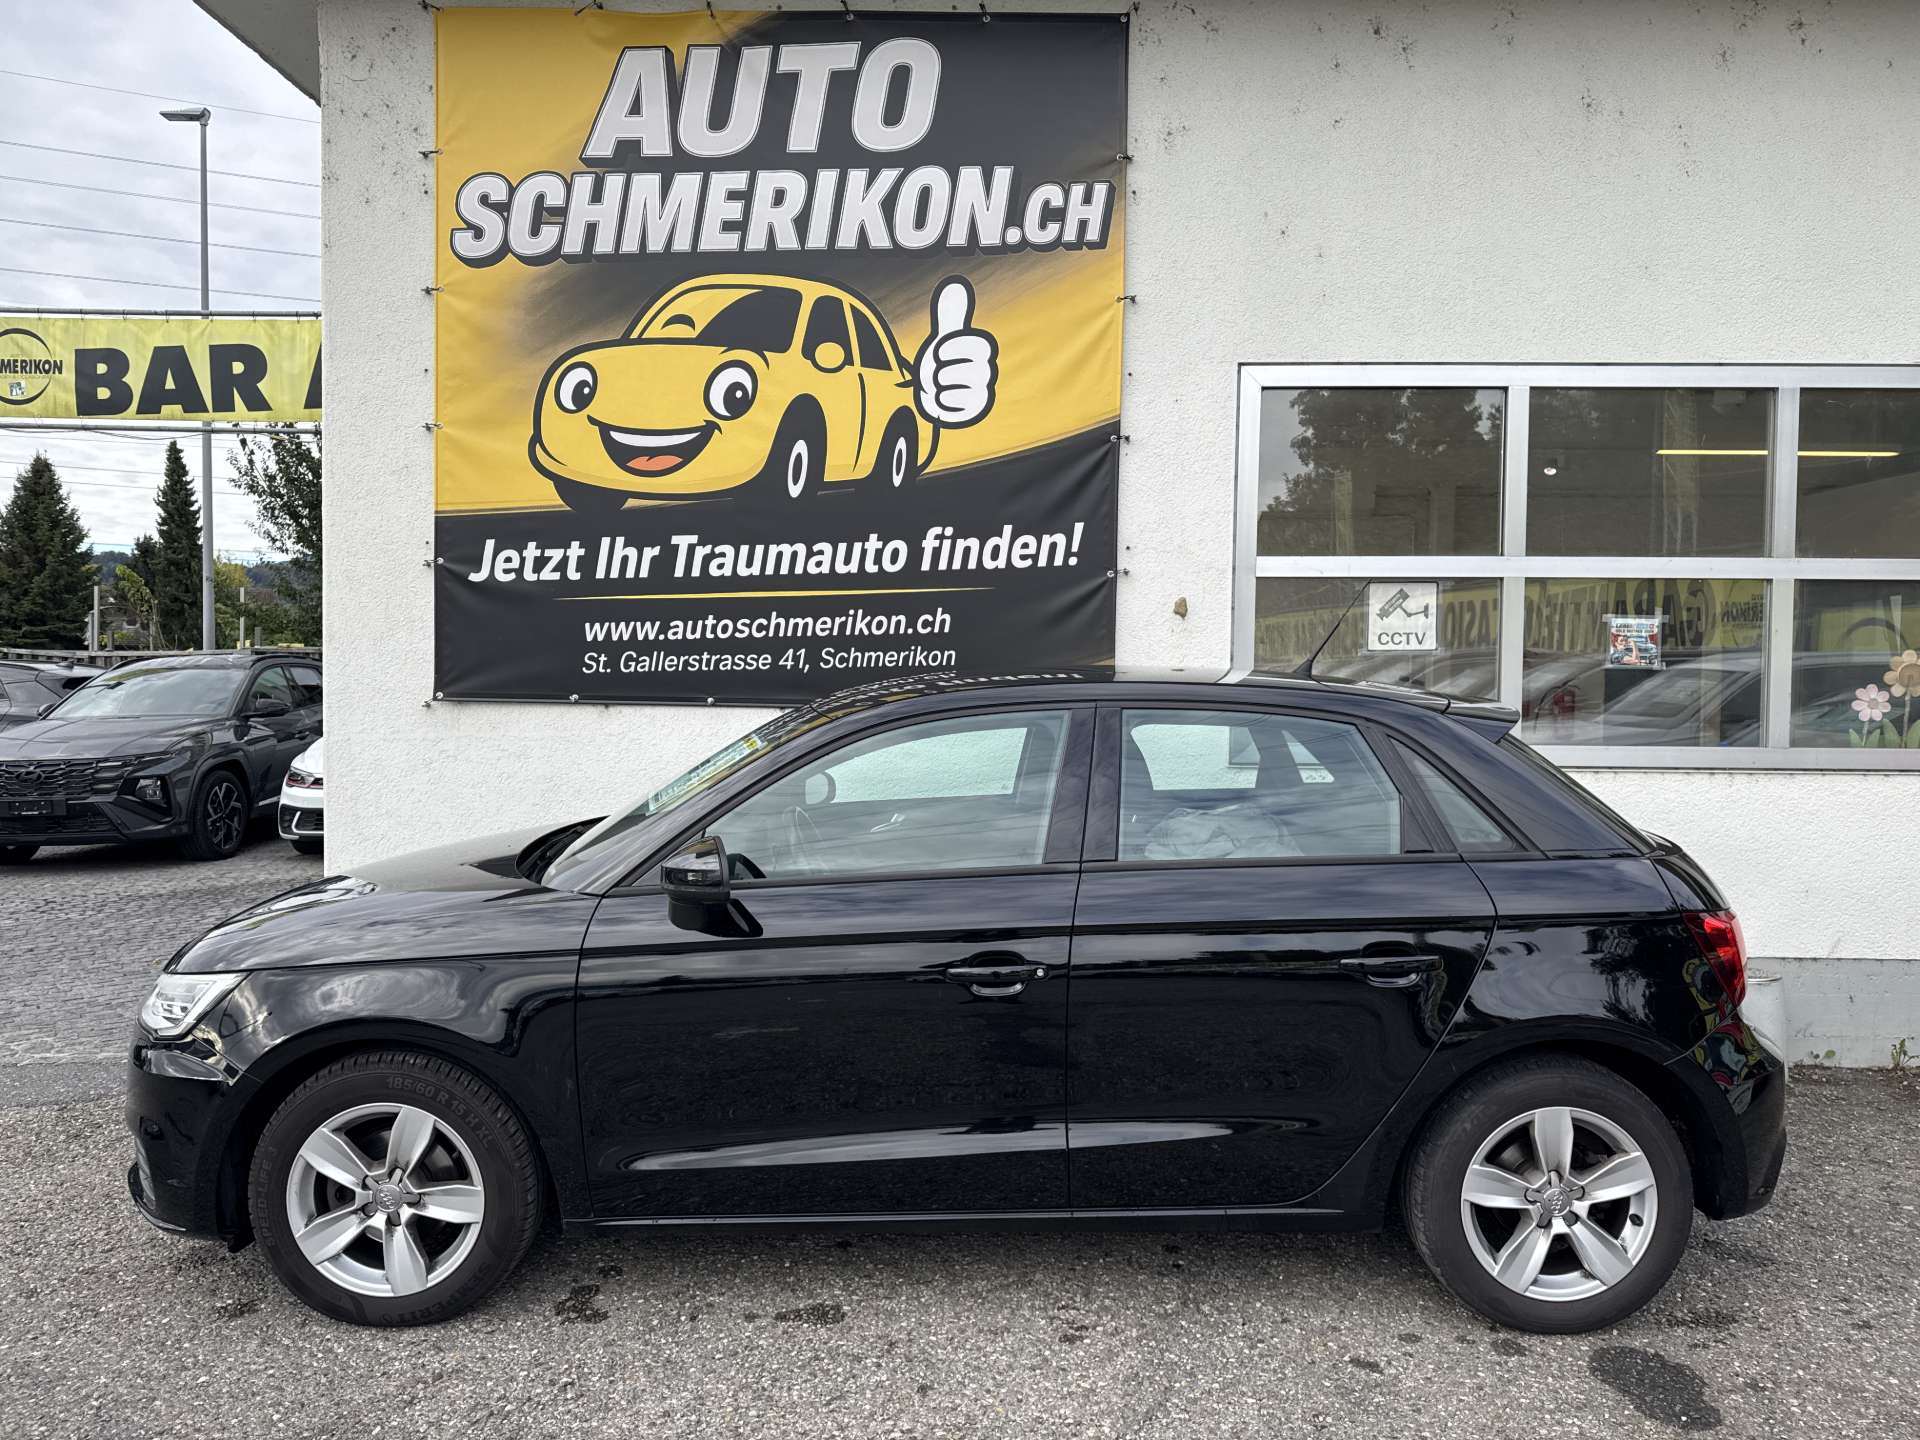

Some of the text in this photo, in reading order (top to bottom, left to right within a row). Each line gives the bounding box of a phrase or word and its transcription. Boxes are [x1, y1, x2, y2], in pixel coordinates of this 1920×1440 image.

[581, 37, 942, 159] AUTO
[452, 165, 1109, 259] SCHMERIKON.CH
[74, 343, 273, 417] BAR
[468, 522, 1085, 583] Jetzt Ihr Traumauto finden!
[584, 607, 952, 642] www.autoschmerikon.ch
[1377, 632, 1427, 646] CCTV
[583, 646, 957, 674] St. Gallerstrasse 41, Schmerikon
[436, 1091, 449, 1105] R
[451, 1100, 467, 1116] 15
[465, 1113, 480, 1128] H
